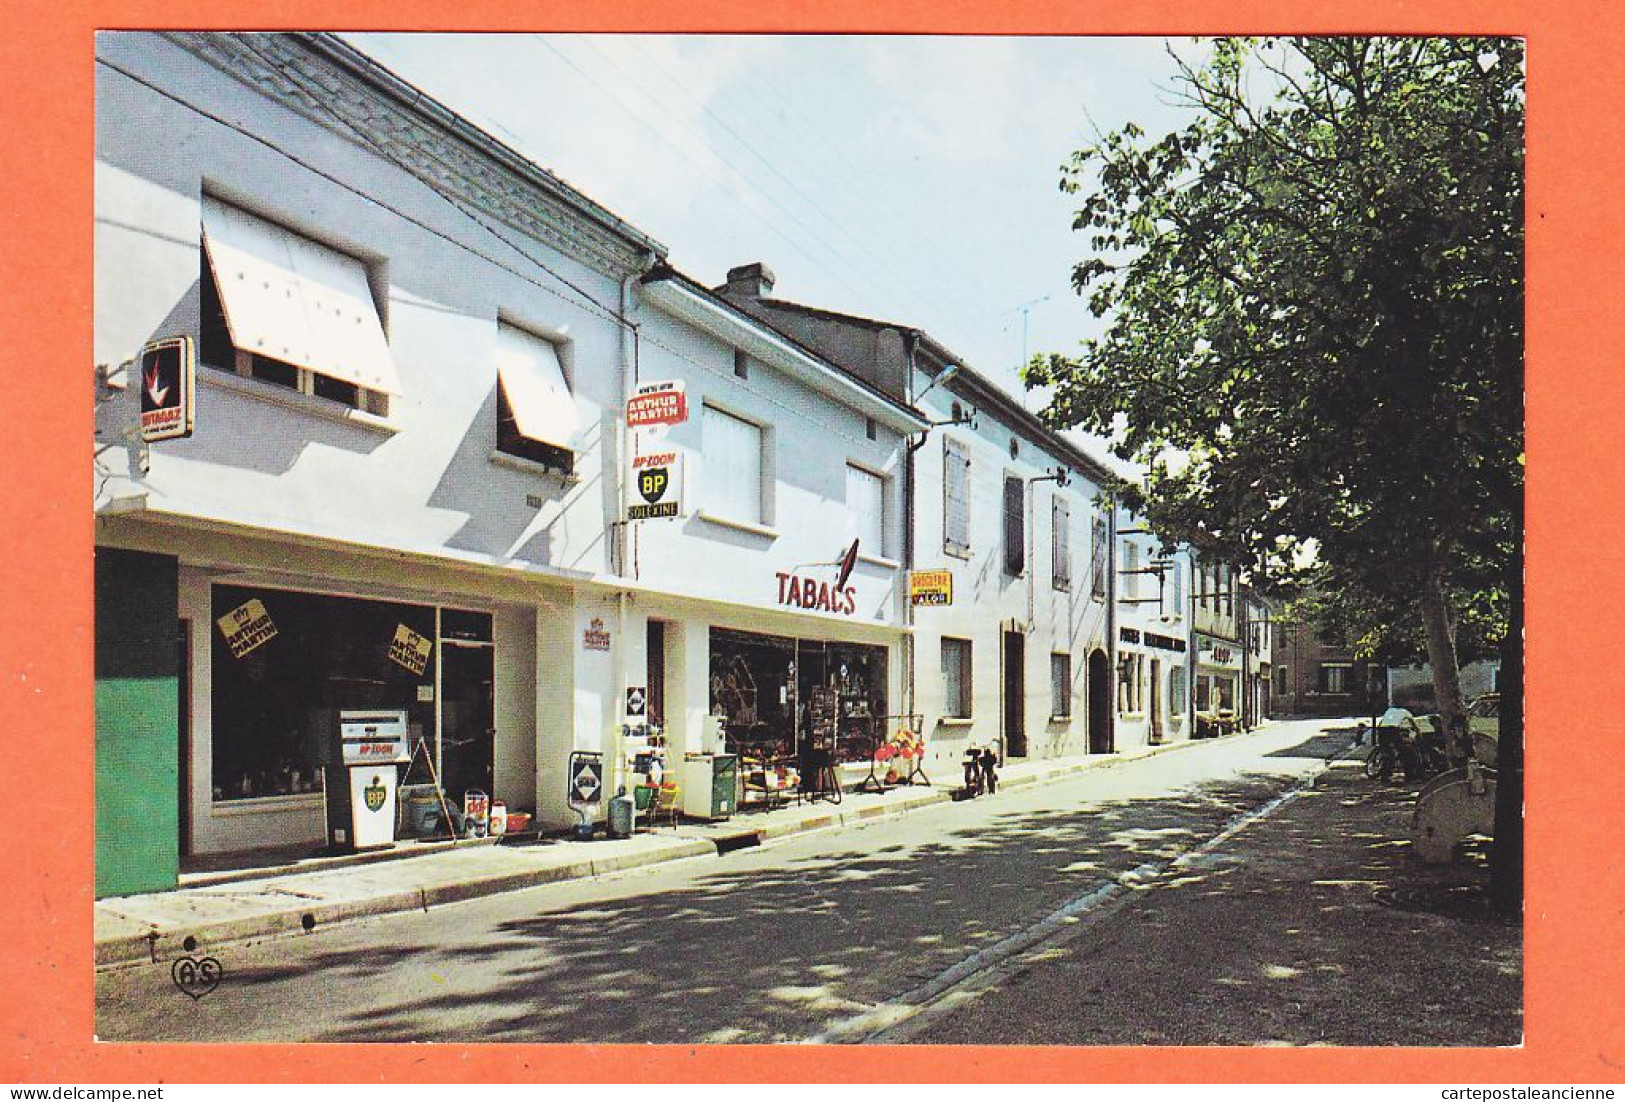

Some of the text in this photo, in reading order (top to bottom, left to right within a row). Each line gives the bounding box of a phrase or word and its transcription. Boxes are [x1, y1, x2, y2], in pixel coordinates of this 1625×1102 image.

[629, 396, 677, 411] ARTHUR
[629, 407, 679, 421] MARTIN
[642, 474, 665, 494] BP
[628, 502, 677, 519] SOLEXINE
[775, 571, 856, 616] TABACS
[228, 615, 270, 645] ARTHUR
[232, 624, 276, 656] MARTIN
[390, 647, 425, 673] MARTIN
[393, 638, 427, 663] ARTHUR
[367, 791, 385, 805] BP
